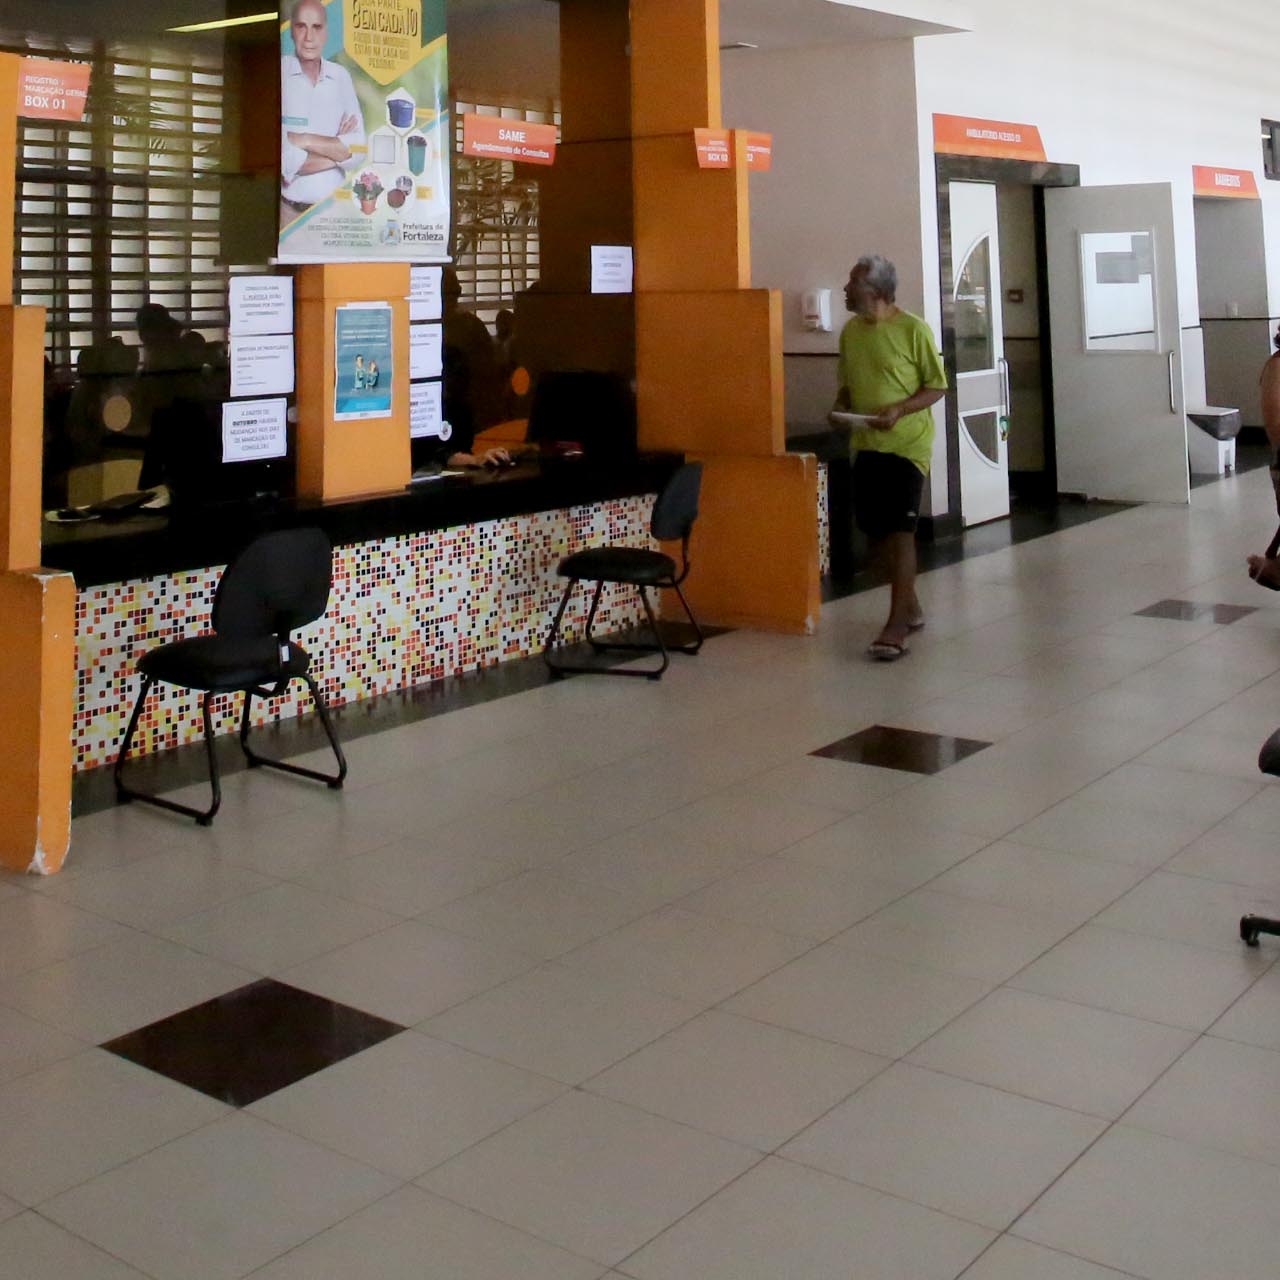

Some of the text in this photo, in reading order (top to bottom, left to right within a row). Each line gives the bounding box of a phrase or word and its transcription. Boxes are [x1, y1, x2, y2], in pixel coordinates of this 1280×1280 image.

[24, 95, 66, 110] BOX 01
[498, 128, 527, 143] SAME
[402, 223, 433, 231] Prefeitura
[402, 231, 444, 242] Fortaleza
